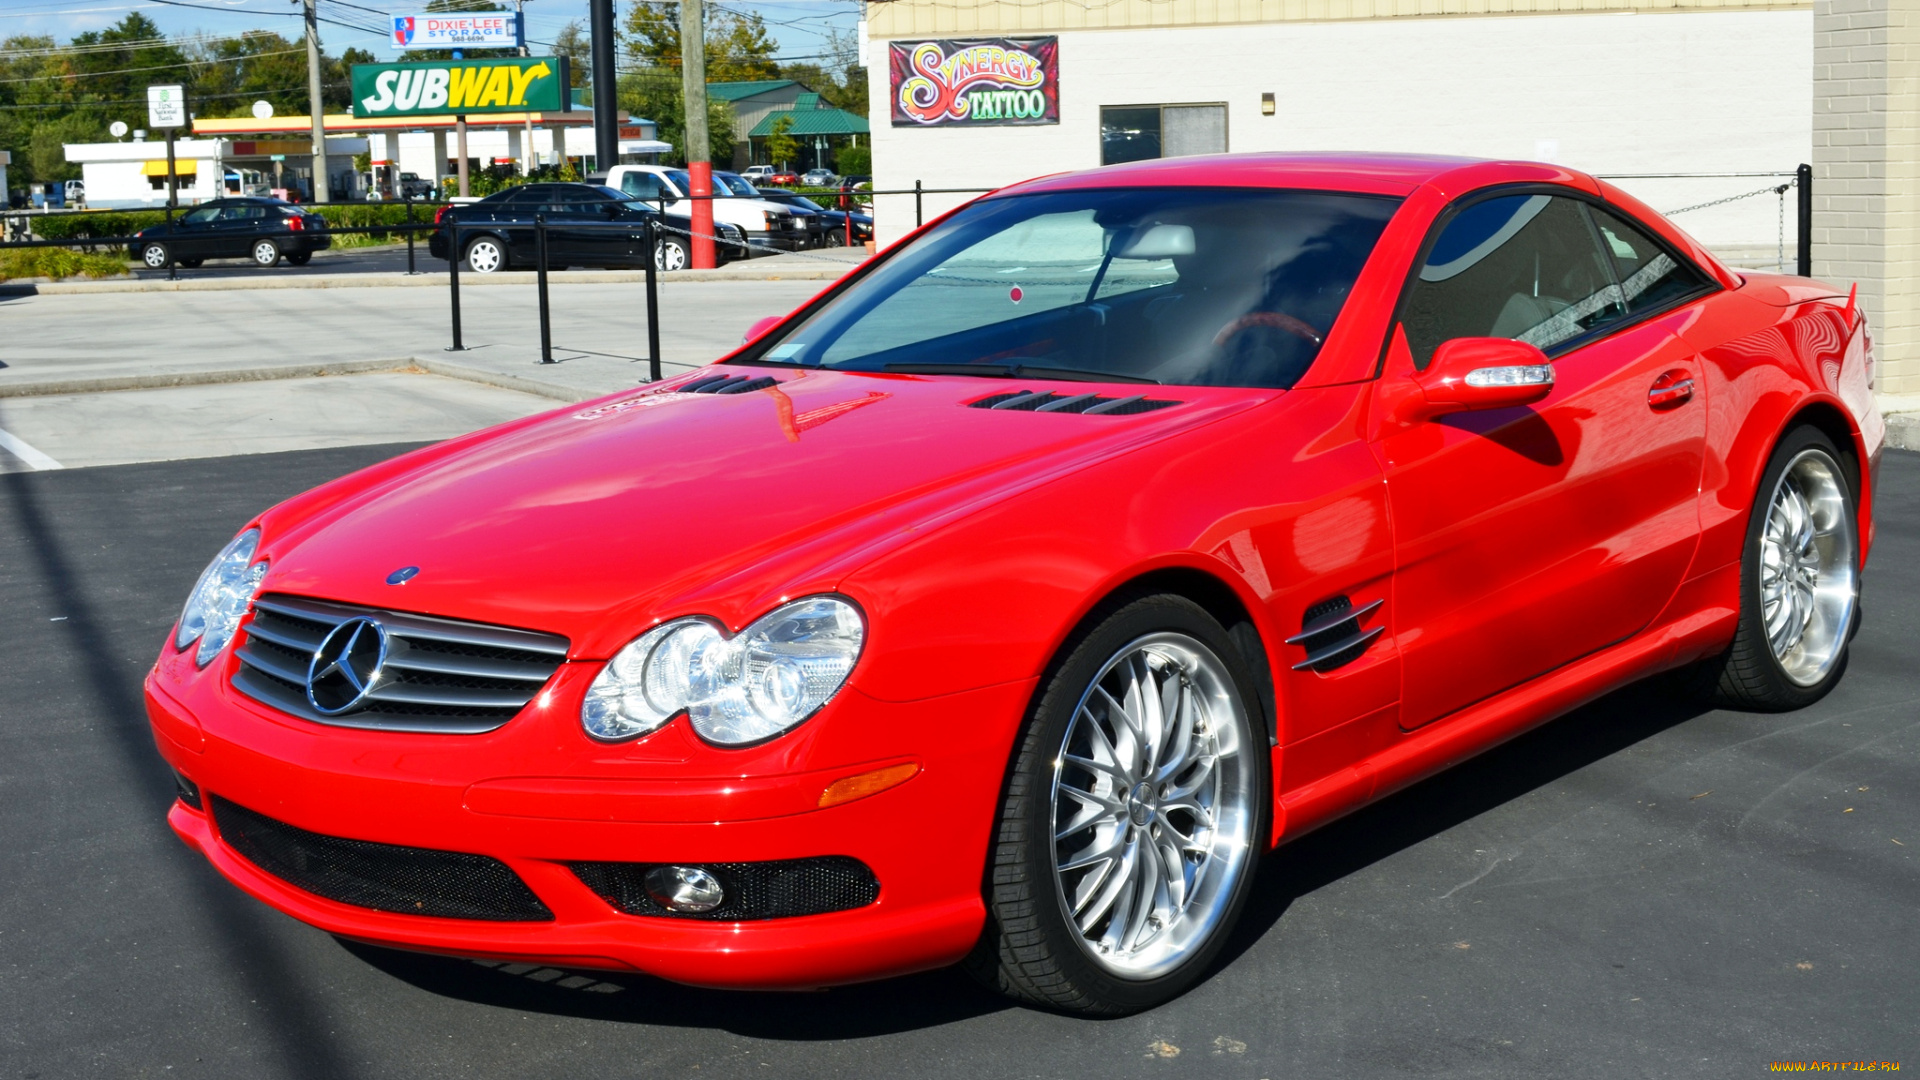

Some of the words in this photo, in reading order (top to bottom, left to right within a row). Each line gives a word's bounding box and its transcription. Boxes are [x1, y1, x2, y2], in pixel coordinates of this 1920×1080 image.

[428, 28, 503, 38] STORAGE
[361, 61, 551, 114] SUBWAY
[901, 43, 1044, 121] SYNERGY
[969, 89, 1045, 119] TATTOO
